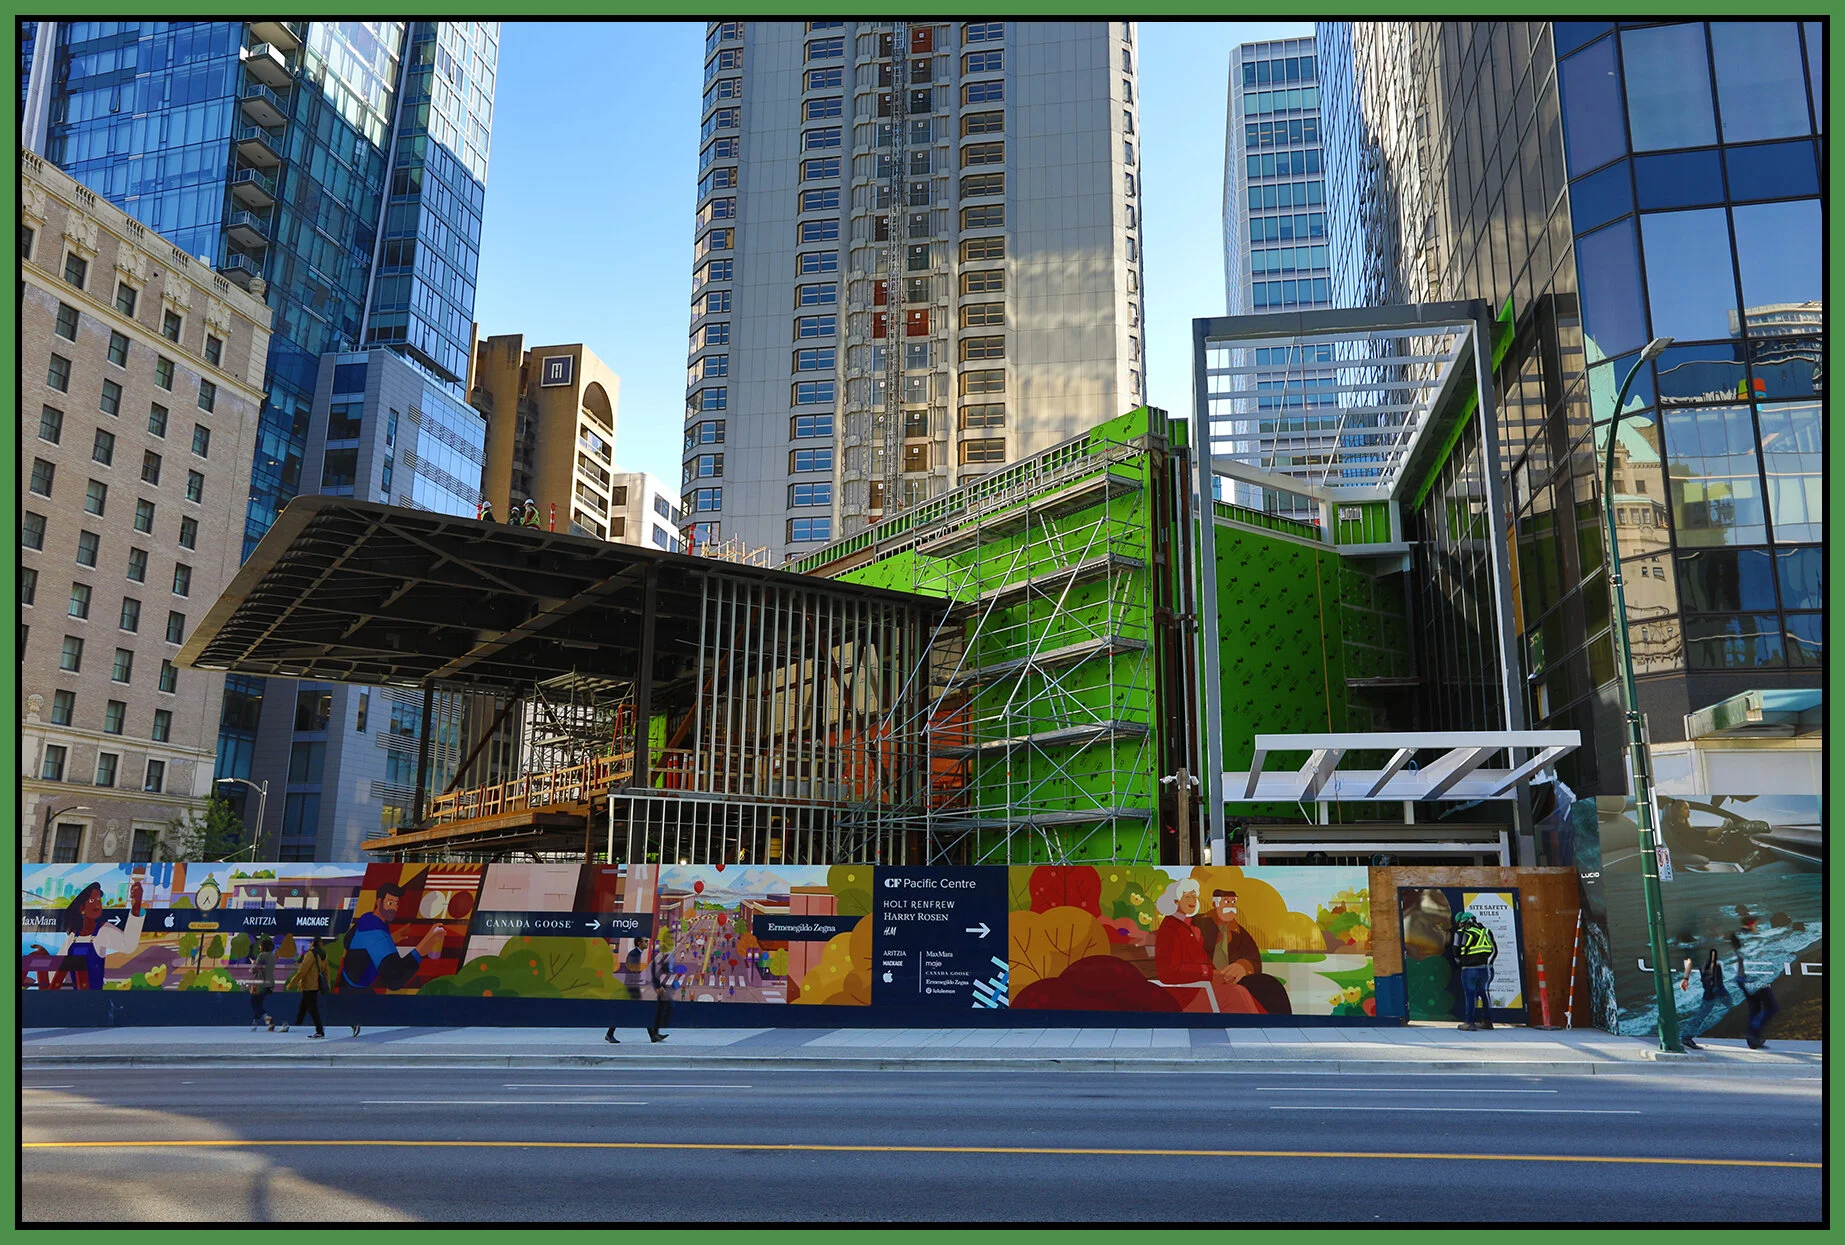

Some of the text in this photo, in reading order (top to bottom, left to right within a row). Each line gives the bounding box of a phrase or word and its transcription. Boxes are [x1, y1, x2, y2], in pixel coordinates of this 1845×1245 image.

[884, 878, 977, 889] CF Pacific Centre
[883, 900, 955, 909] HOLT RENFREW
[242, 916, 278, 926] ARITZIA
[295, 916, 330, 927] MACKAGE
[883, 912, 949, 921] HARRY ROSEN
[485, 919, 572, 929] CANADA GOOSE
[612, 917, 639, 930] maje
[767, 922, 836, 934] Ermenegildo Zegna
[925, 960, 942, 968] maje
